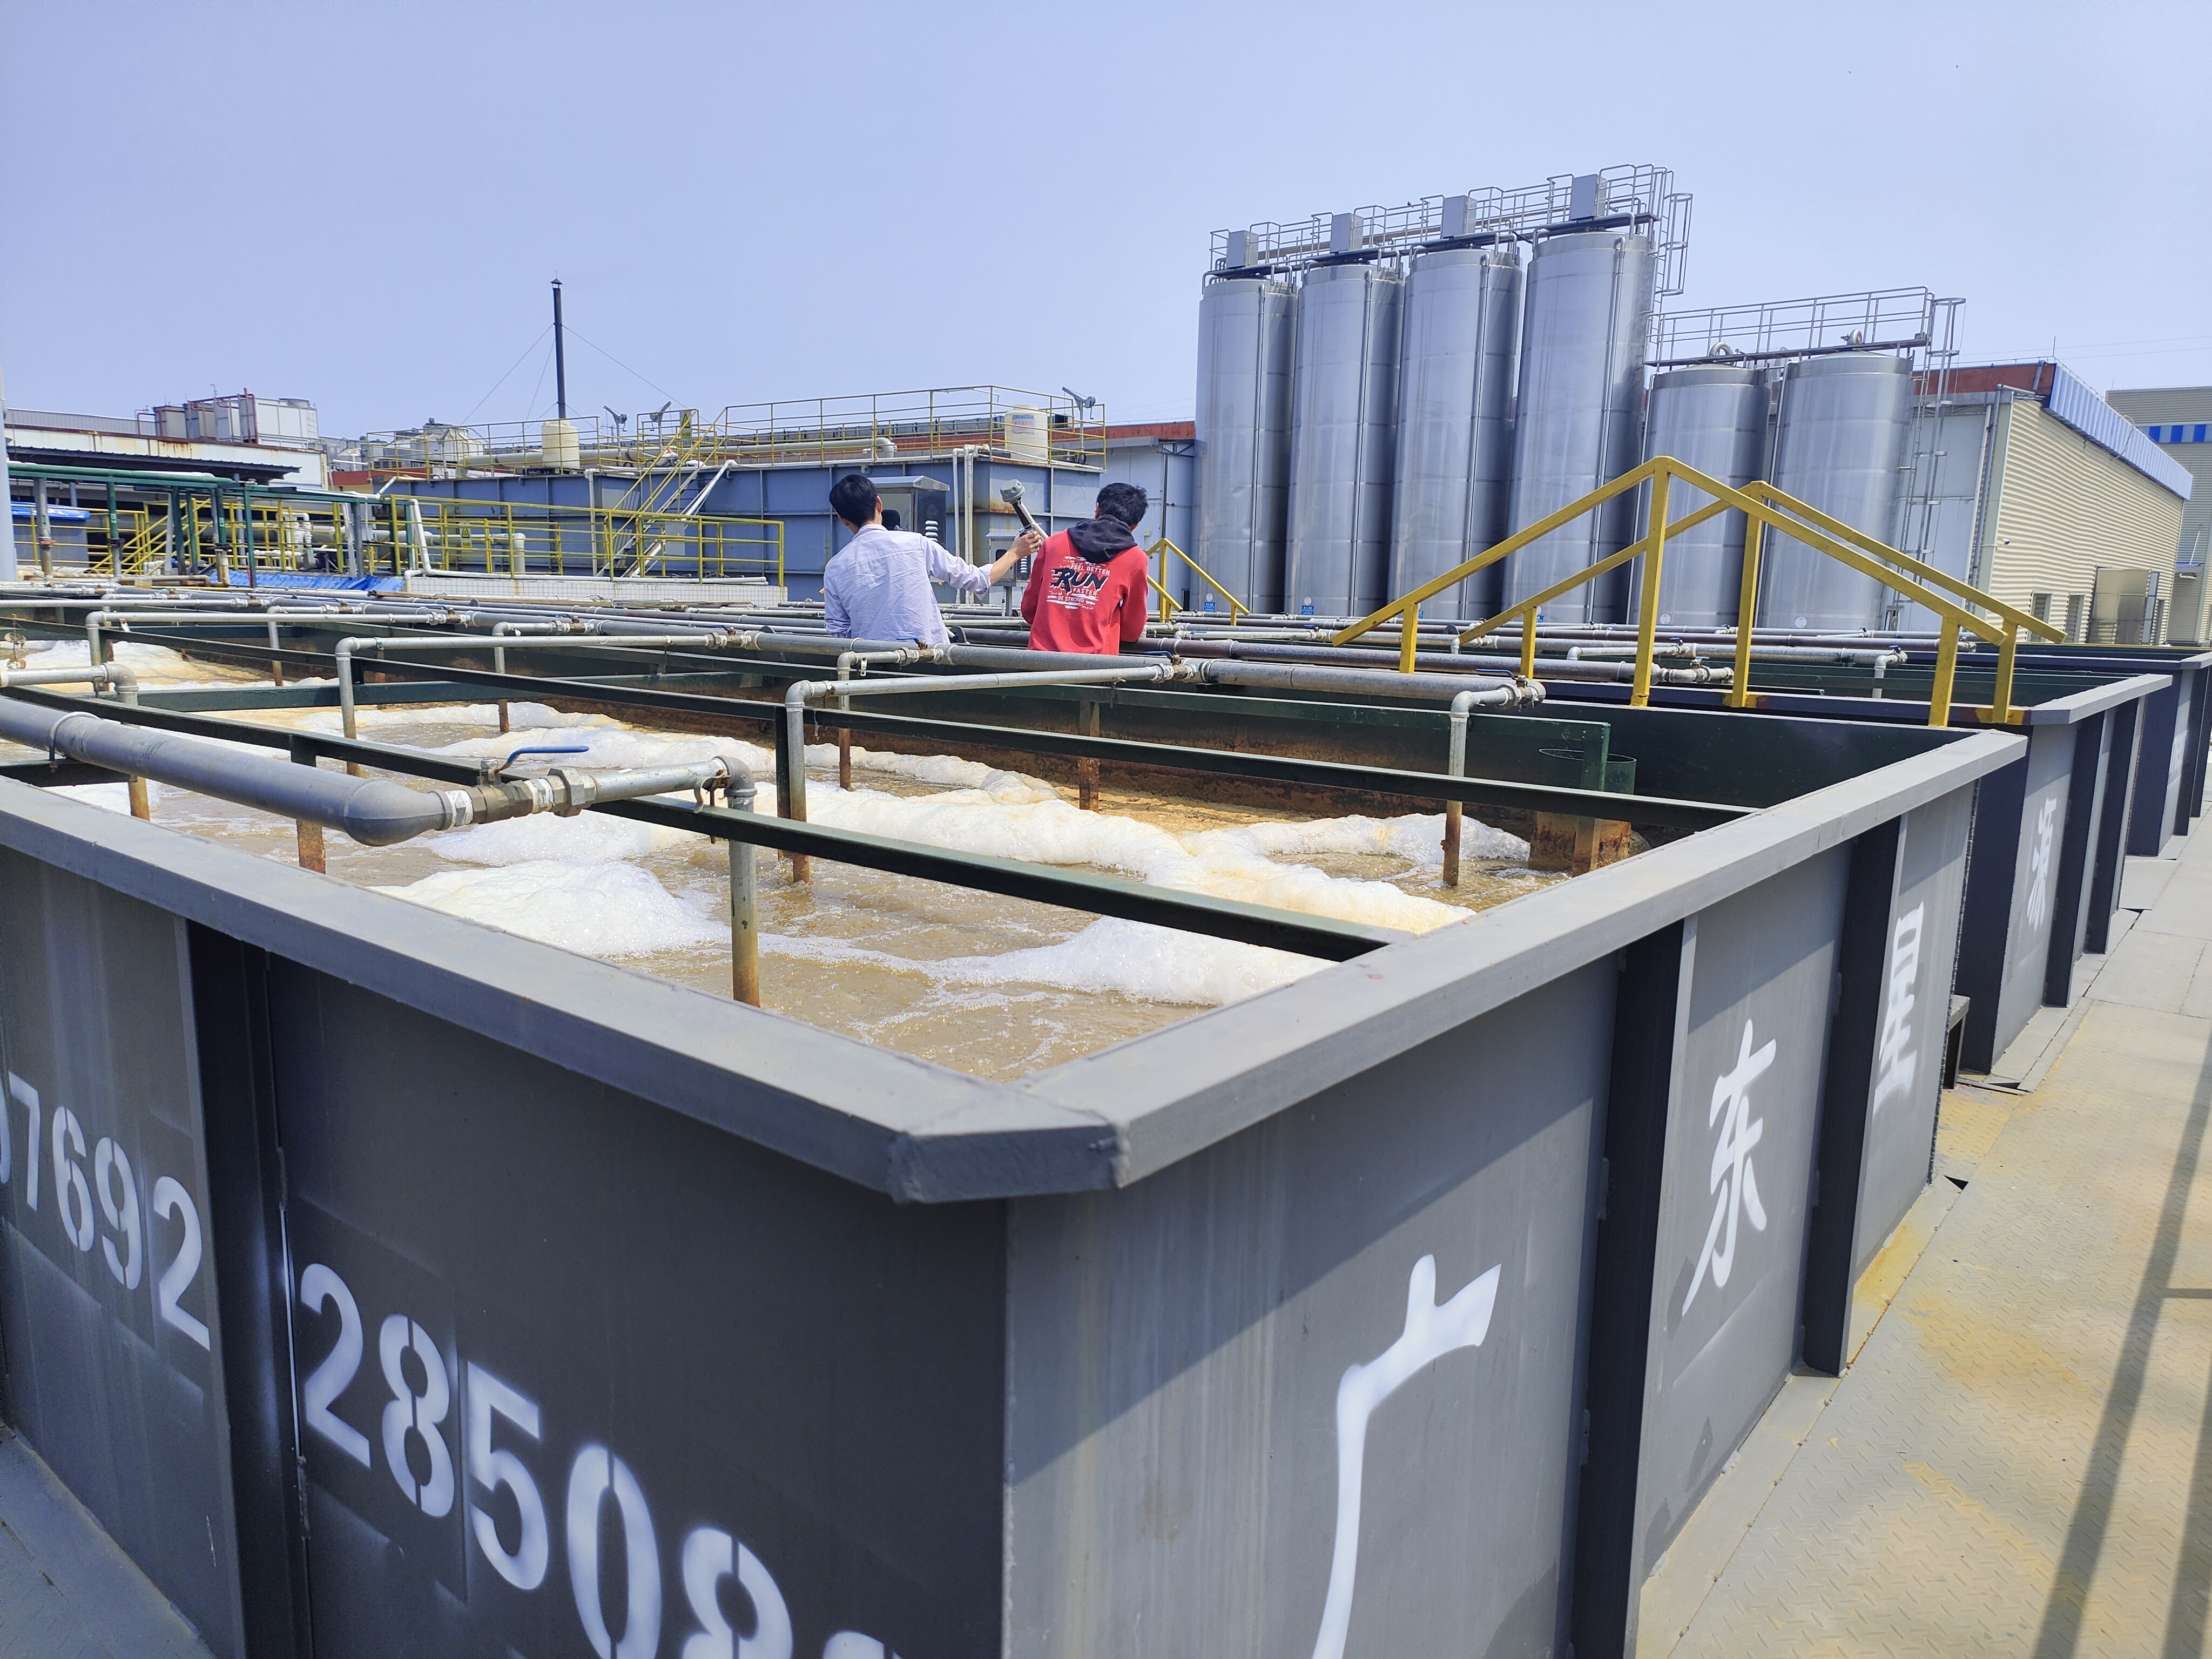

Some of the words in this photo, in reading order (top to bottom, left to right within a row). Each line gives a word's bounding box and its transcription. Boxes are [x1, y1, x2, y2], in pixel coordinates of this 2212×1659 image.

[1087, 566, 1110, 576] BETTER
[1050, 568, 1109, 595] RUN
[1073, 588, 1097, 597] FASTER
[0, 1071, 211, 1351] 7692
